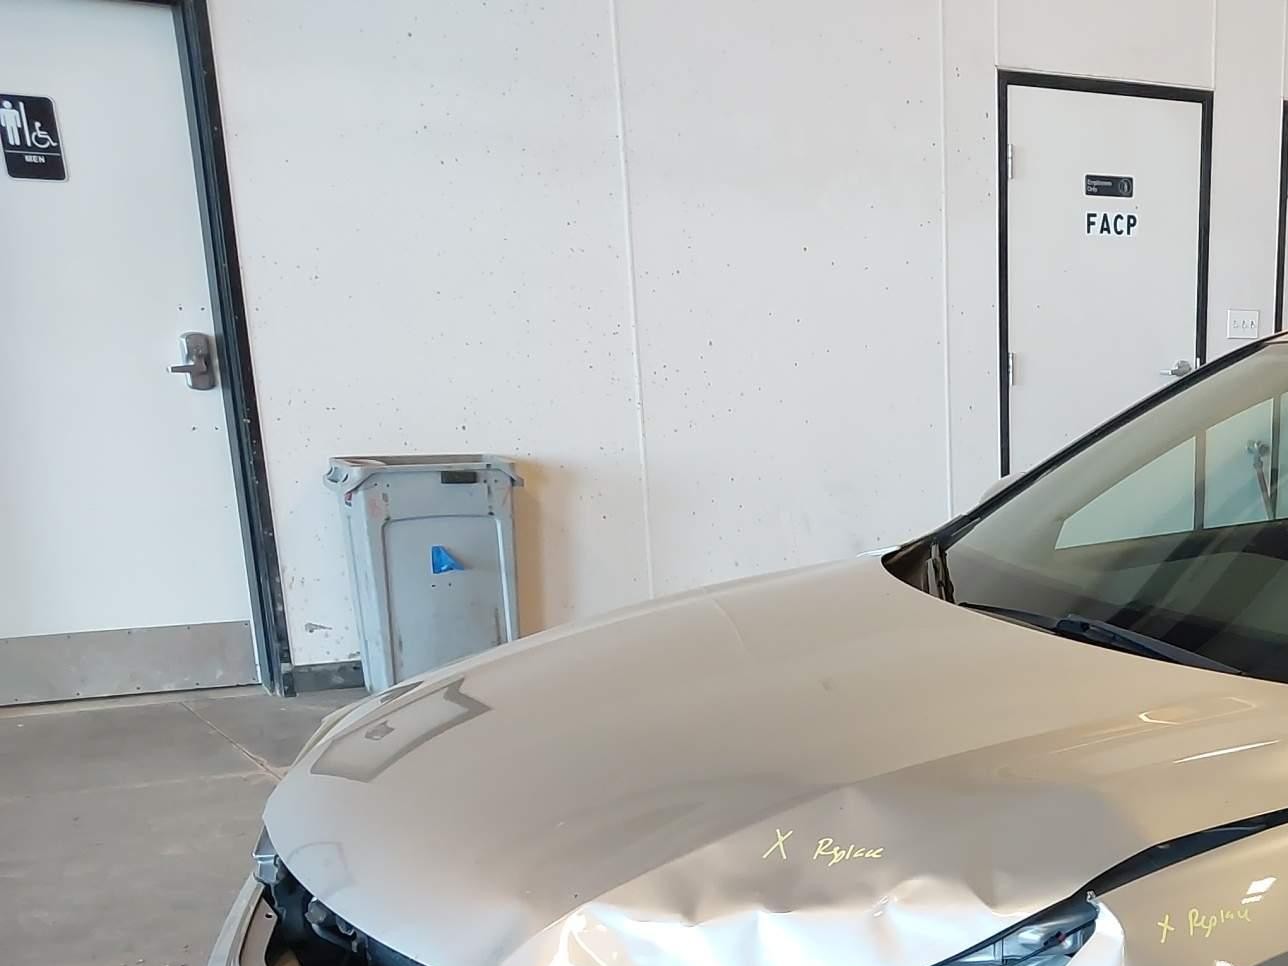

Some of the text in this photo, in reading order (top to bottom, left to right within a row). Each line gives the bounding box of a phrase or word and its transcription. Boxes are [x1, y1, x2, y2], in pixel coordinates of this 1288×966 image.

[24, 155, 45, 163] MEN
[1086, 212, 1137, 235] FACP
[762, 829, 793, 859] X
